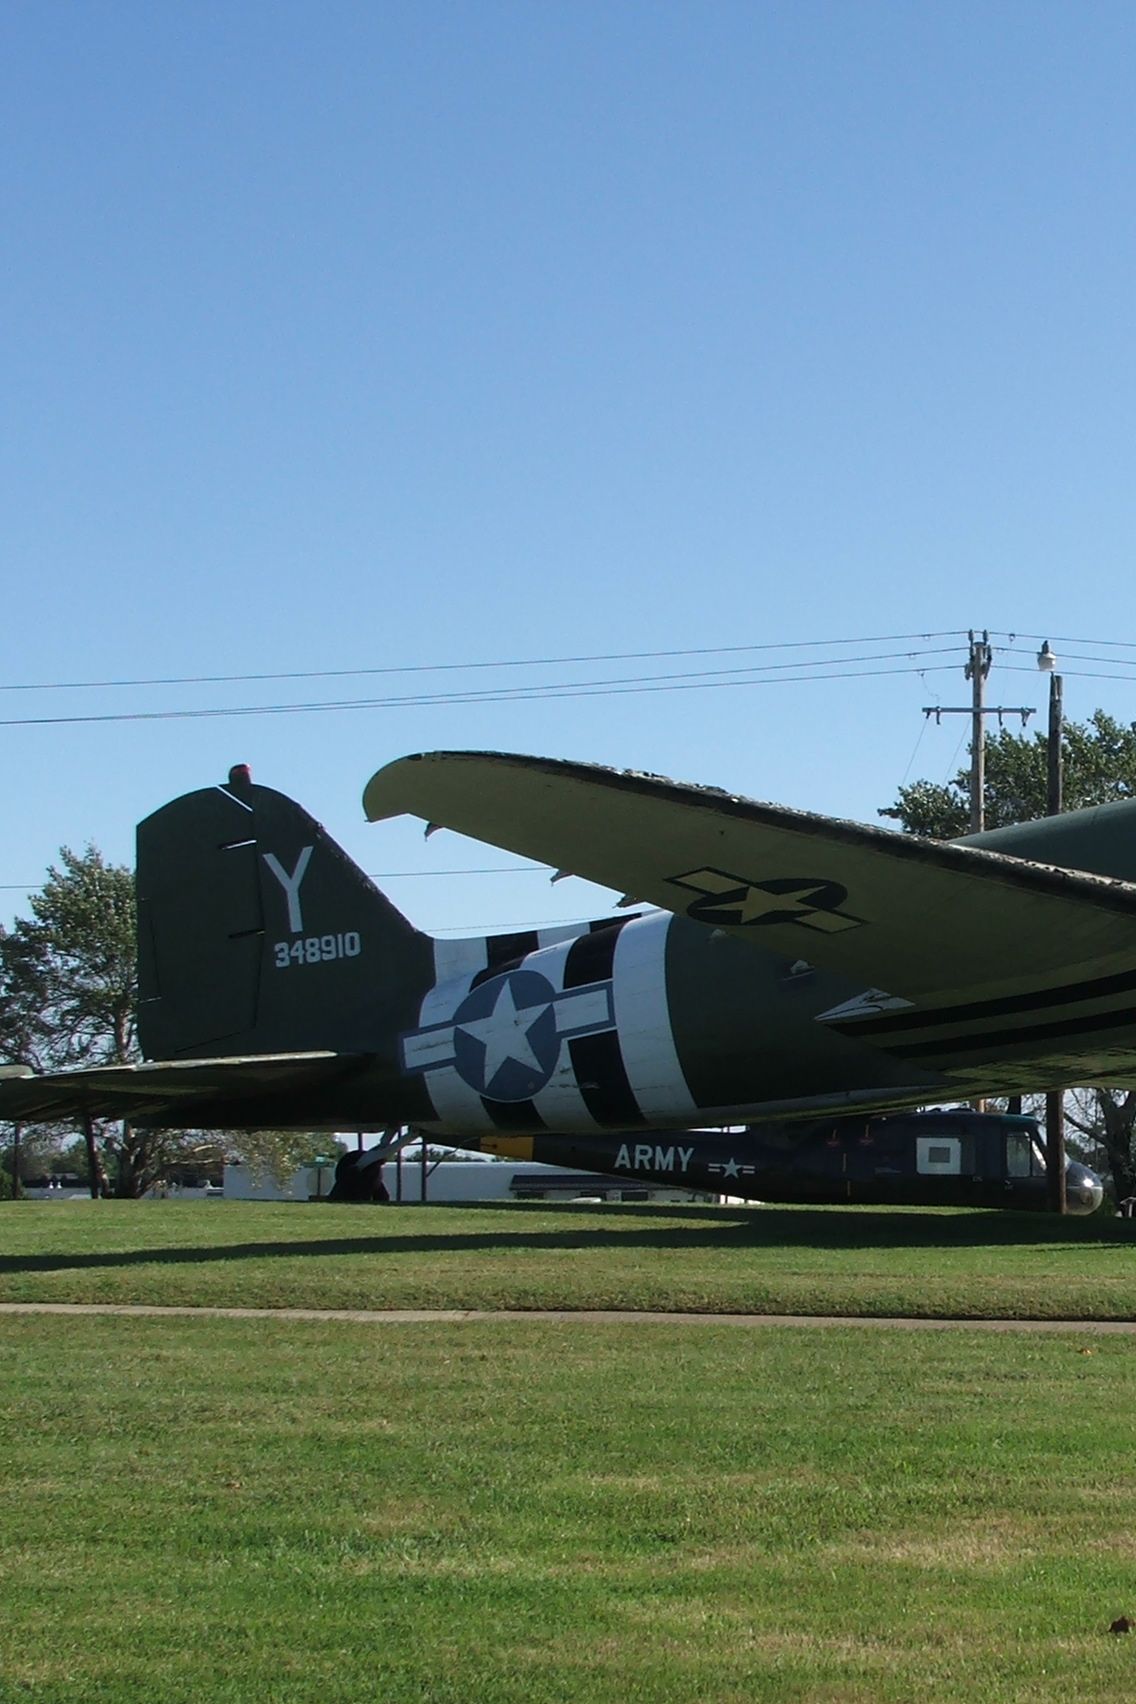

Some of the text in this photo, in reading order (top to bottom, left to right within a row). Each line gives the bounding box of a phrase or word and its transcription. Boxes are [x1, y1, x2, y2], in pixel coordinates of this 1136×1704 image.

[263, 846, 313, 932] Y
[274, 932, 361, 967] 348910
[614, 1144, 694, 1171] ARMY
